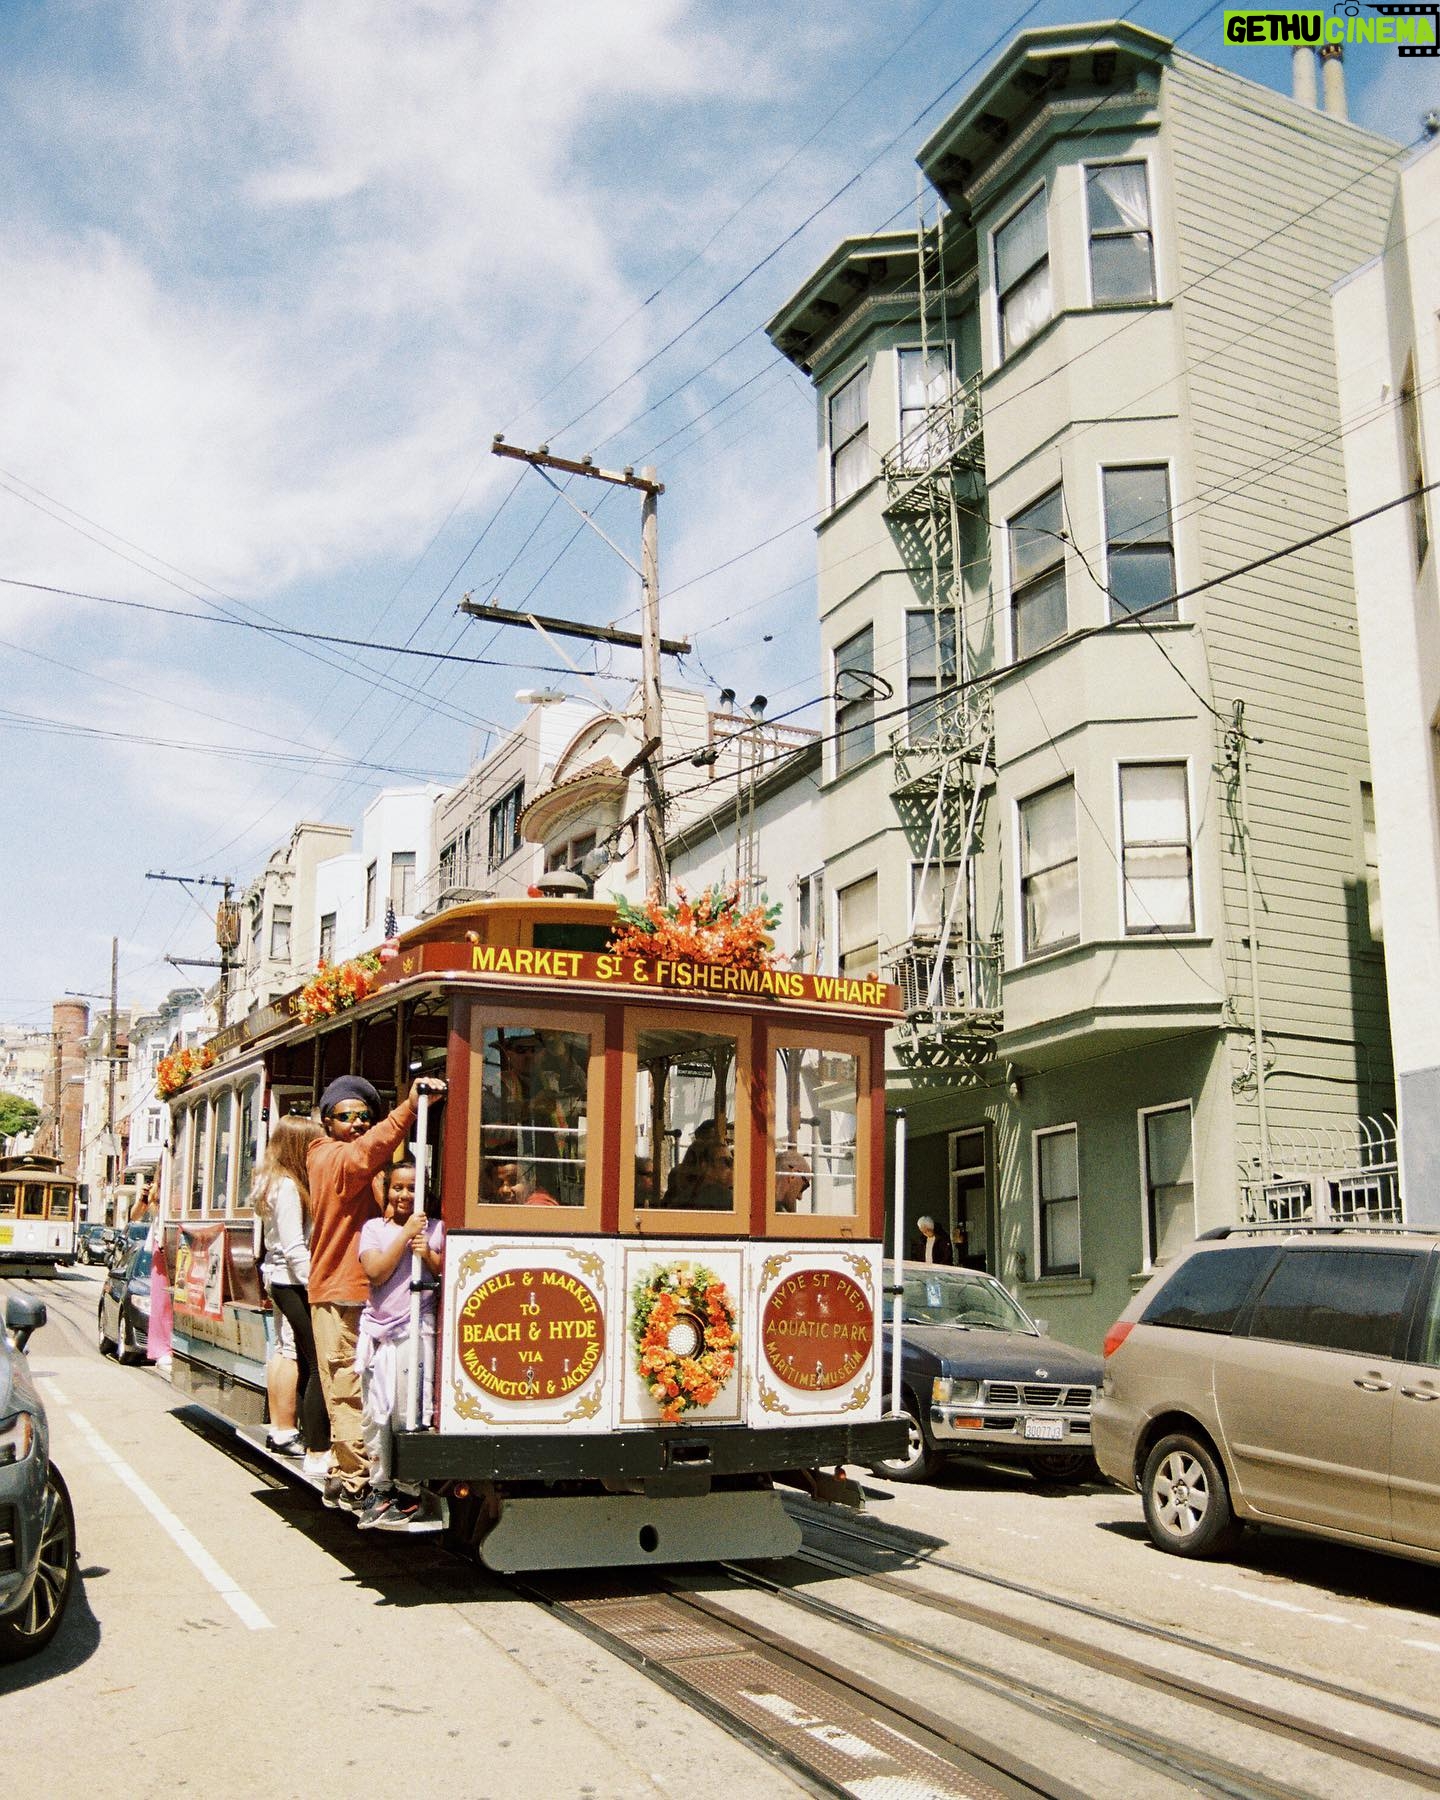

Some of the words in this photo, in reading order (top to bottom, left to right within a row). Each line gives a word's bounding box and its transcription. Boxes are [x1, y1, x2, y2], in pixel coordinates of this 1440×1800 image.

[472, 946, 583, 977] MARKET
[633, 959, 648, 982] &
[656, 960, 804, 997] FISHERMANS
[813, 974, 888, 1005] WHARF
[463, 1273, 515, 1318] POWELL
[522, 1272, 533, 1286] &
[542, 1272, 598, 1315] MARKET
[520, 1304, 540, 1316] TO
[771, 1275, 806, 1309] HYDE
[813, 1274, 830, 1288] ST
[836, 1280, 865, 1312] PIER
[463, 1323, 521, 1343] BEACH
[528, 1322, 541, 1341] &
[549, 1320, 597, 1340] HYDE
[766, 1319, 829, 1338] AQUATIC
[833, 1324, 868, 1342] PARK
[462, 1348, 540, 1395] WASHINGTON
[547, 1380, 556, 1394] &
[560, 1341, 600, 1391] JACKSON
[518, 1351, 543, 1363] VIA
[766, 1341, 817, 1386] MARITIME
[822, 1350, 863, 1385] MUSEUM
